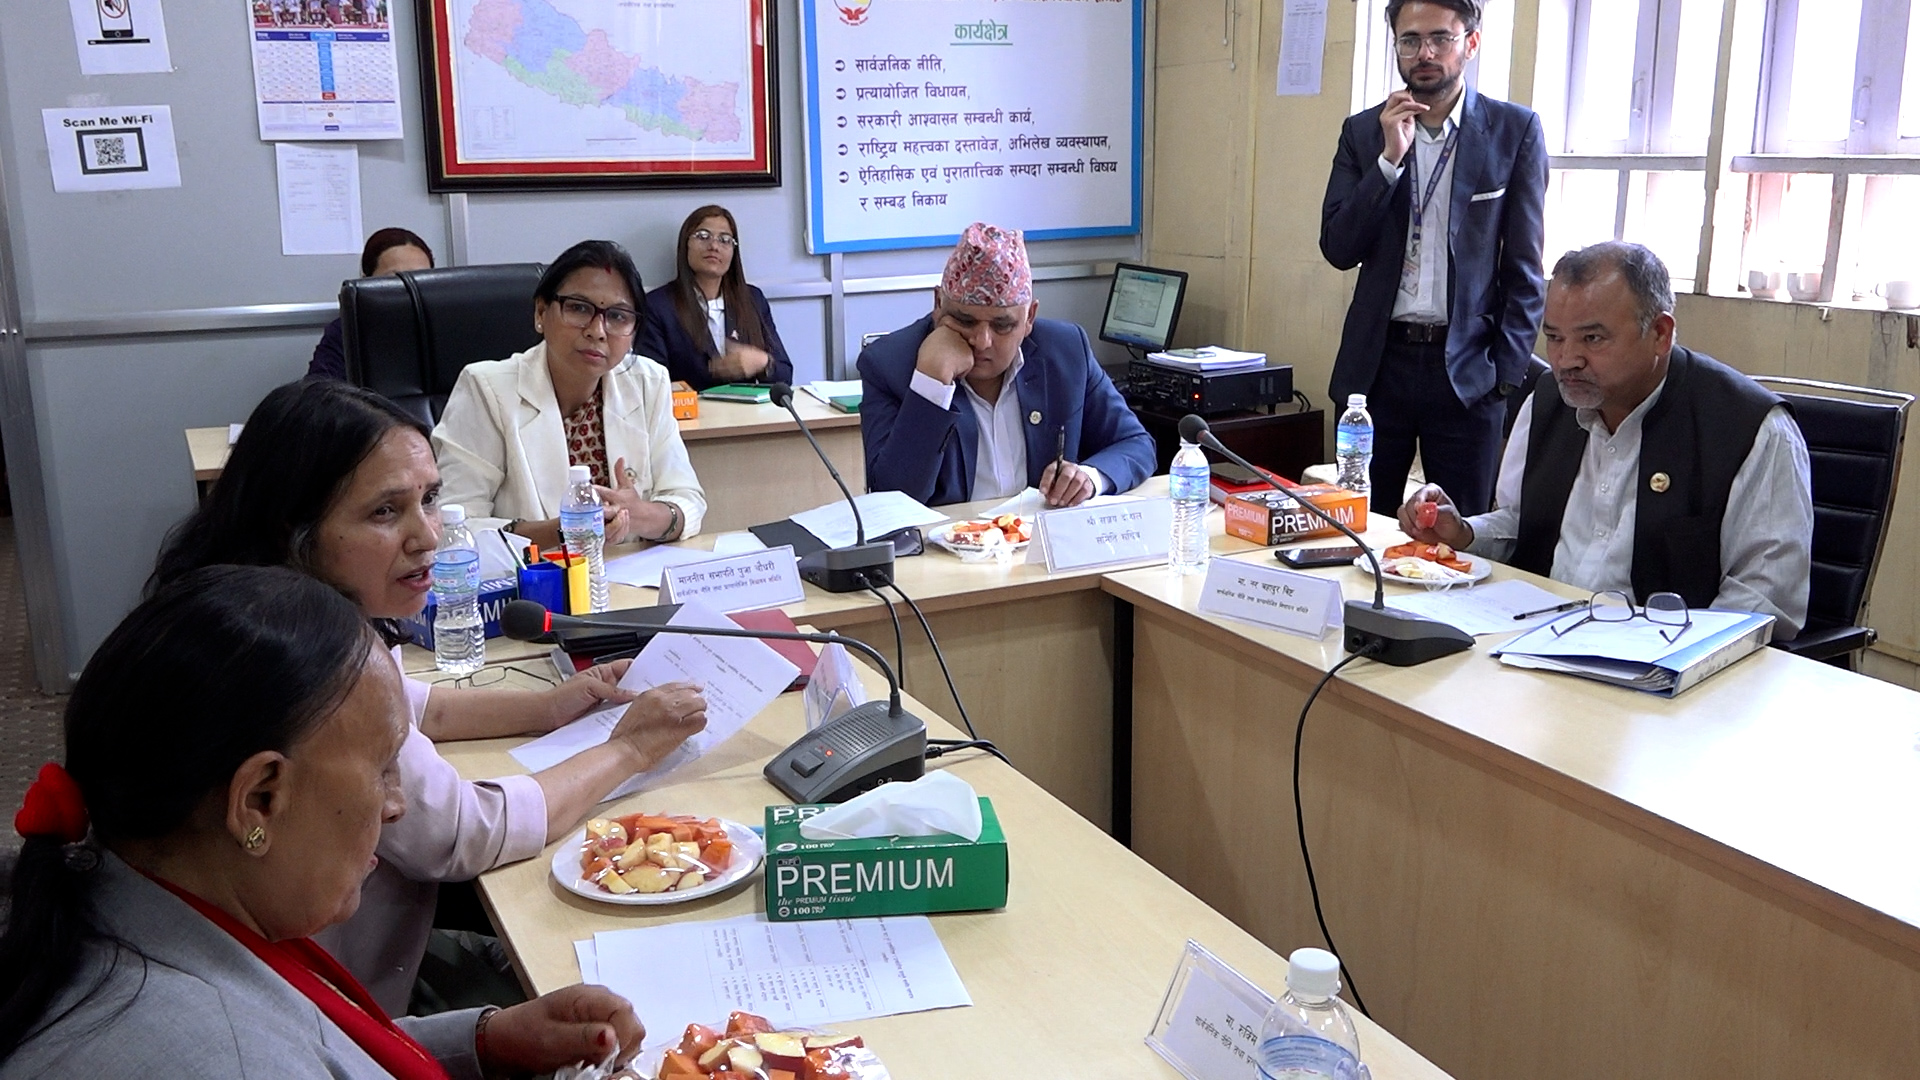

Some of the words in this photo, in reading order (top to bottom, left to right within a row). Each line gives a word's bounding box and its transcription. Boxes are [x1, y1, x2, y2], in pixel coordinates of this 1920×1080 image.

[954, 19, 1009, 41] कार्यक्षेत्र
[855, 54, 912, 73] सार्वजनिक
[917, 54, 946, 73] नीति,
[856, 82, 919, 101] प्रत्यायोजित
[925, 81, 971, 100] विधायन,
[63, 118, 95, 128] Scan
[99, 117, 118, 126] Me
[121, 115, 153, 125] Wi-Fi
[857, 110, 902, 129] सरकारी
[908, 113, 958, 128] आश्वासन
[964, 108, 1004, 127] सम्बन्धी
[1008, 107, 1035, 125] कार्य,
[857, 138, 898, 159] राष्ट्रिय
[955, 136, 1002, 154] दस्तावेज,
[1008, 133, 1051, 151] अभिलेख
[1056, 135, 1111, 151] व्यवस्थापन,
[858, 164, 915, 185] ऐतिहासिक
[921, 164, 938, 183] एवं
[1009, 163, 1042, 178] सम्पदा
[1047, 158, 1085, 176] सम्बन्धी
[1090, 157, 1118, 174] विषय
[859, 197, 868, 212] र
[911, 191, 948, 207] निकाय
[1227, 503, 1266, 525] PREMIUM
[777, 857, 954, 897] PREMIUM
[777, 897, 793, 907] the
[795, 896, 827, 905] PREMIUM
[828, 894, 857, 903] tissue
[793, 907, 811, 915] 100
[1237, 1023, 1259, 1046] रुक्मि
